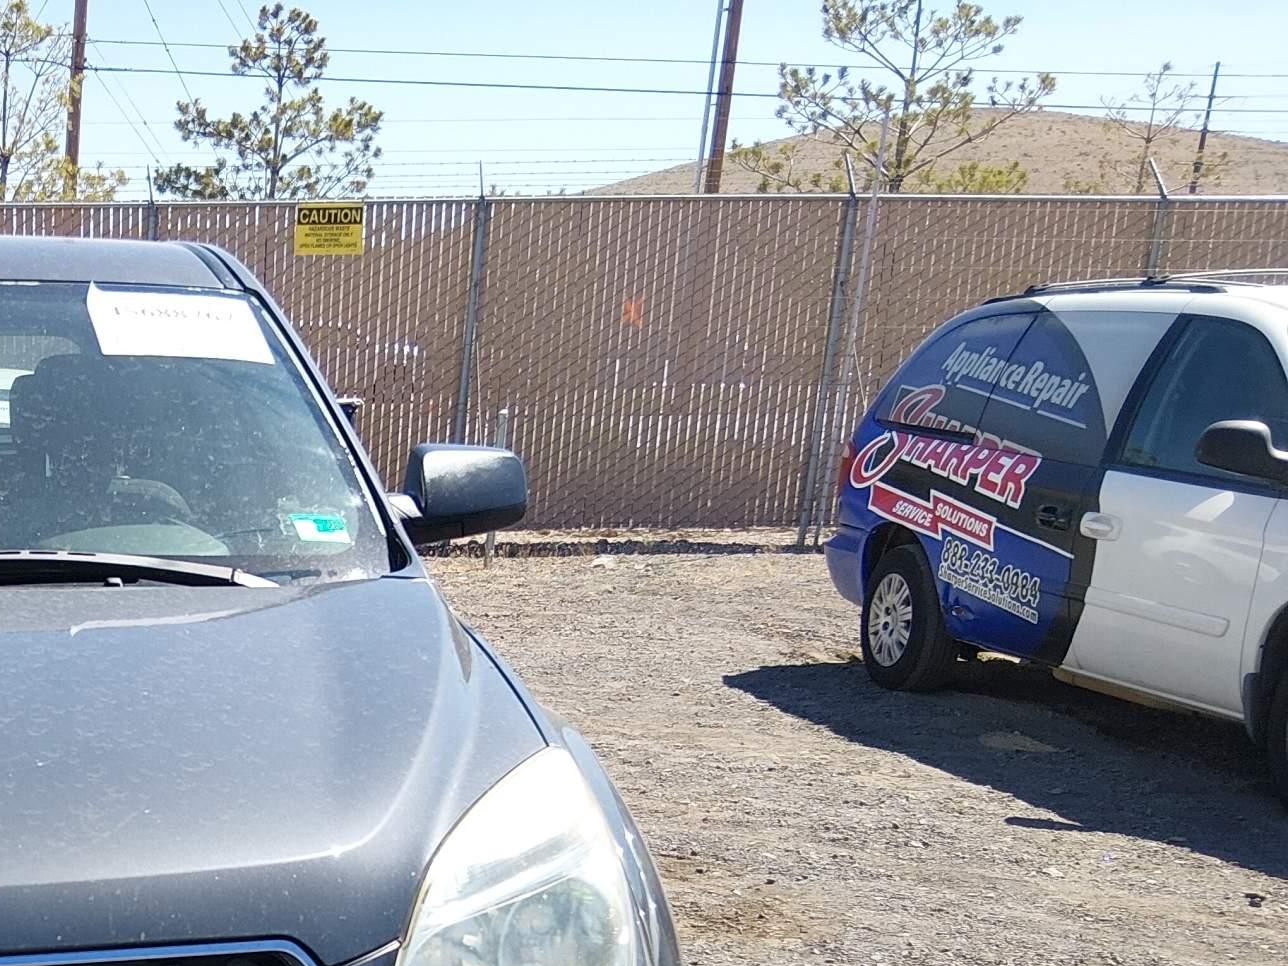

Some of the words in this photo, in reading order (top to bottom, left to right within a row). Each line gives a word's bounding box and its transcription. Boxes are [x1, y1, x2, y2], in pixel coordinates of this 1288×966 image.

[299, 209, 361, 224] CAUTION
[941, 342, 1026, 389] Appliance
[1017, 361, 1091, 409] Repair
[850, 384, 1043, 509] SHARPER
[892, 500, 933, 527] SERVICE
[935, 502, 989, 537] SOLUTIONS
[942, 537, 1040, 606] 888-233-0984
